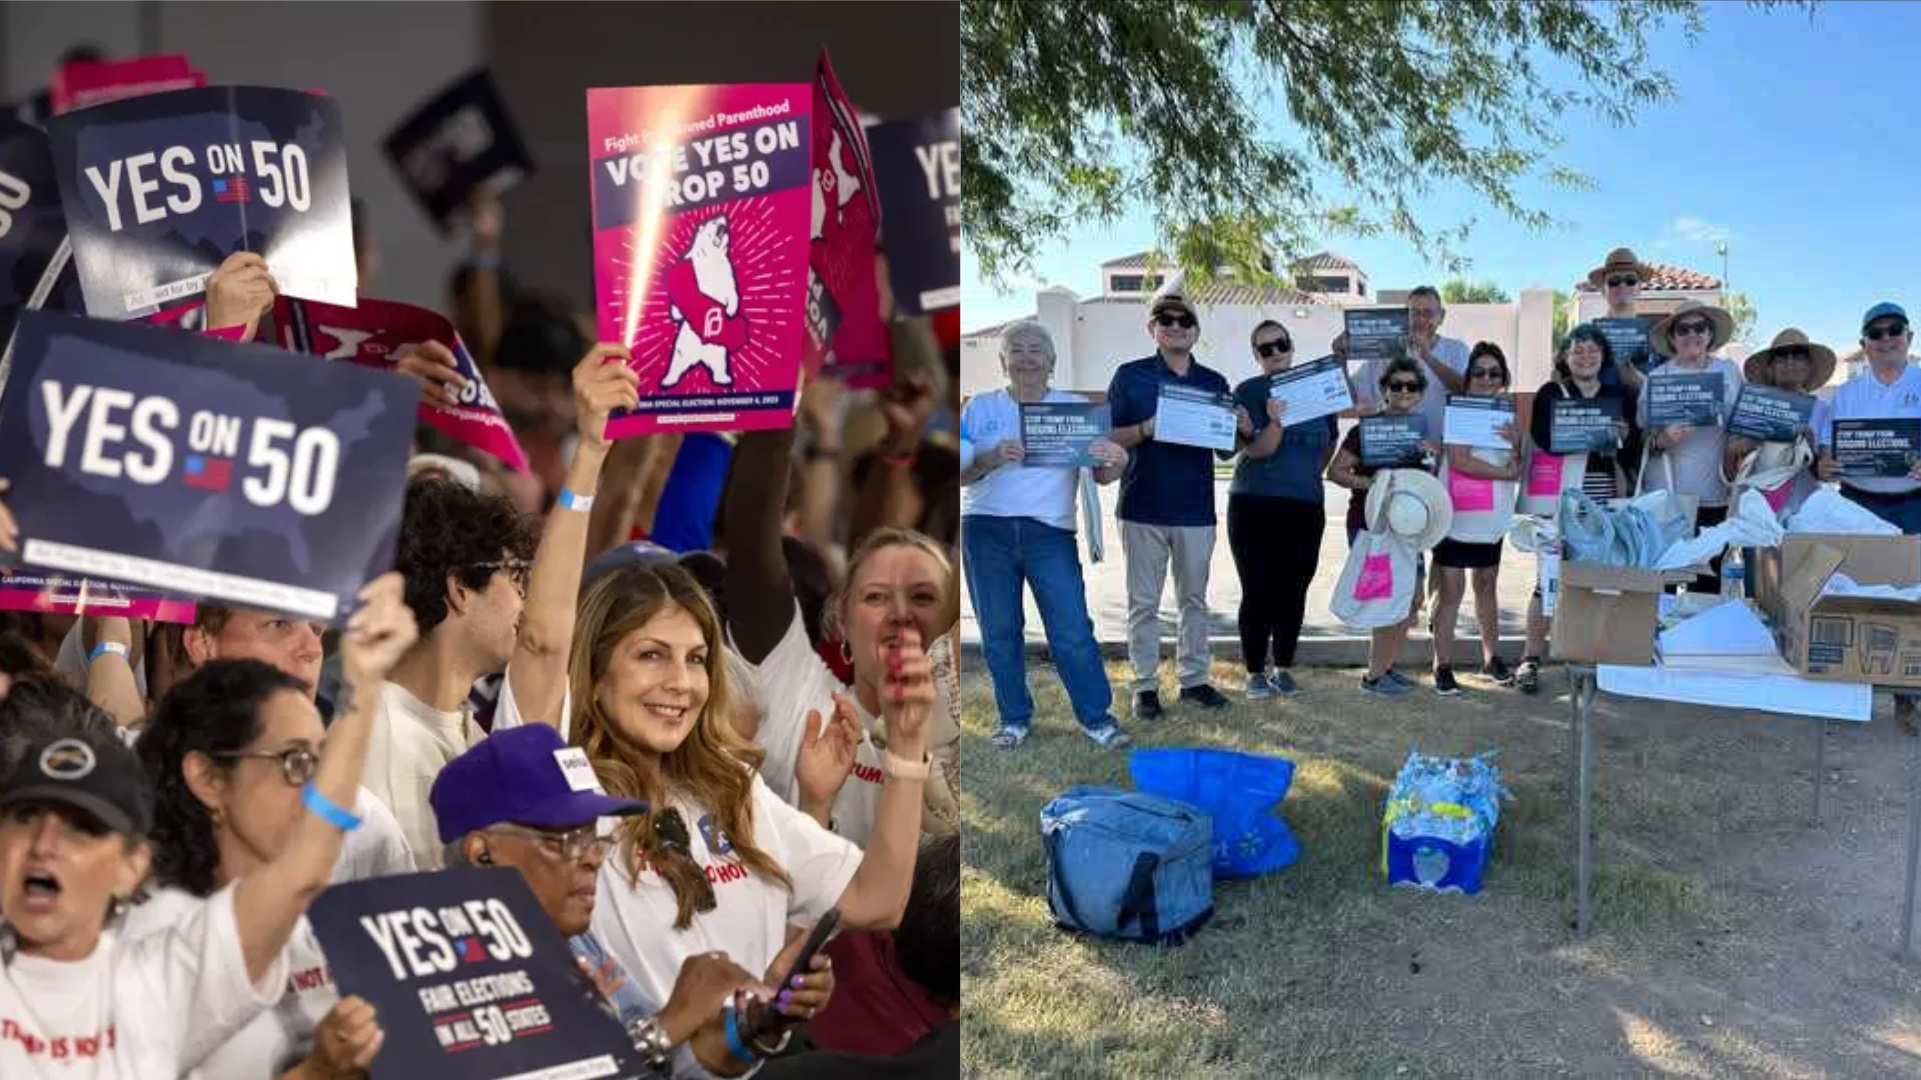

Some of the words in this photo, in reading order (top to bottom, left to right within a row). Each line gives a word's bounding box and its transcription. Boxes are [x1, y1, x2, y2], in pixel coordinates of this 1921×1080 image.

[604, 132, 638, 153] Fight
[717, 98, 790, 127] Parenthood
[605, 144, 689, 186] VOE
[692, 132, 749, 167] YES
[755, 121, 799, 154] ON
[915, 141, 960, 199] YE
[86, 145, 202, 231] YES
[206, 143, 245, 174] ON
[251, 140, 311, 212] 50
[655, 170, 725, 206] ROP
[733, 160, 770, 192] 50
[41, 379, 180, 484] YES
[188, 409, 241, 457] ON
[243, 416, 340, 516] 50
[2, 575, 44, 585] CALIFORNIA
[360, 907, 457, 980] YES
[439, 908, 473, 937] ON
[463, 898, 533, 961] 50
[418, 984, 456, 1014] FAIR
[455, 970, 535, 1006] ELECTIONS
[51, 1036, 68, 1059] IS
[434, 1024, 455, 1047] IN
[453, 1019, 481, 1044] ALL
[473, 1005, 512, 1045] 50
[505, 1004, 552, 1031] STATES
